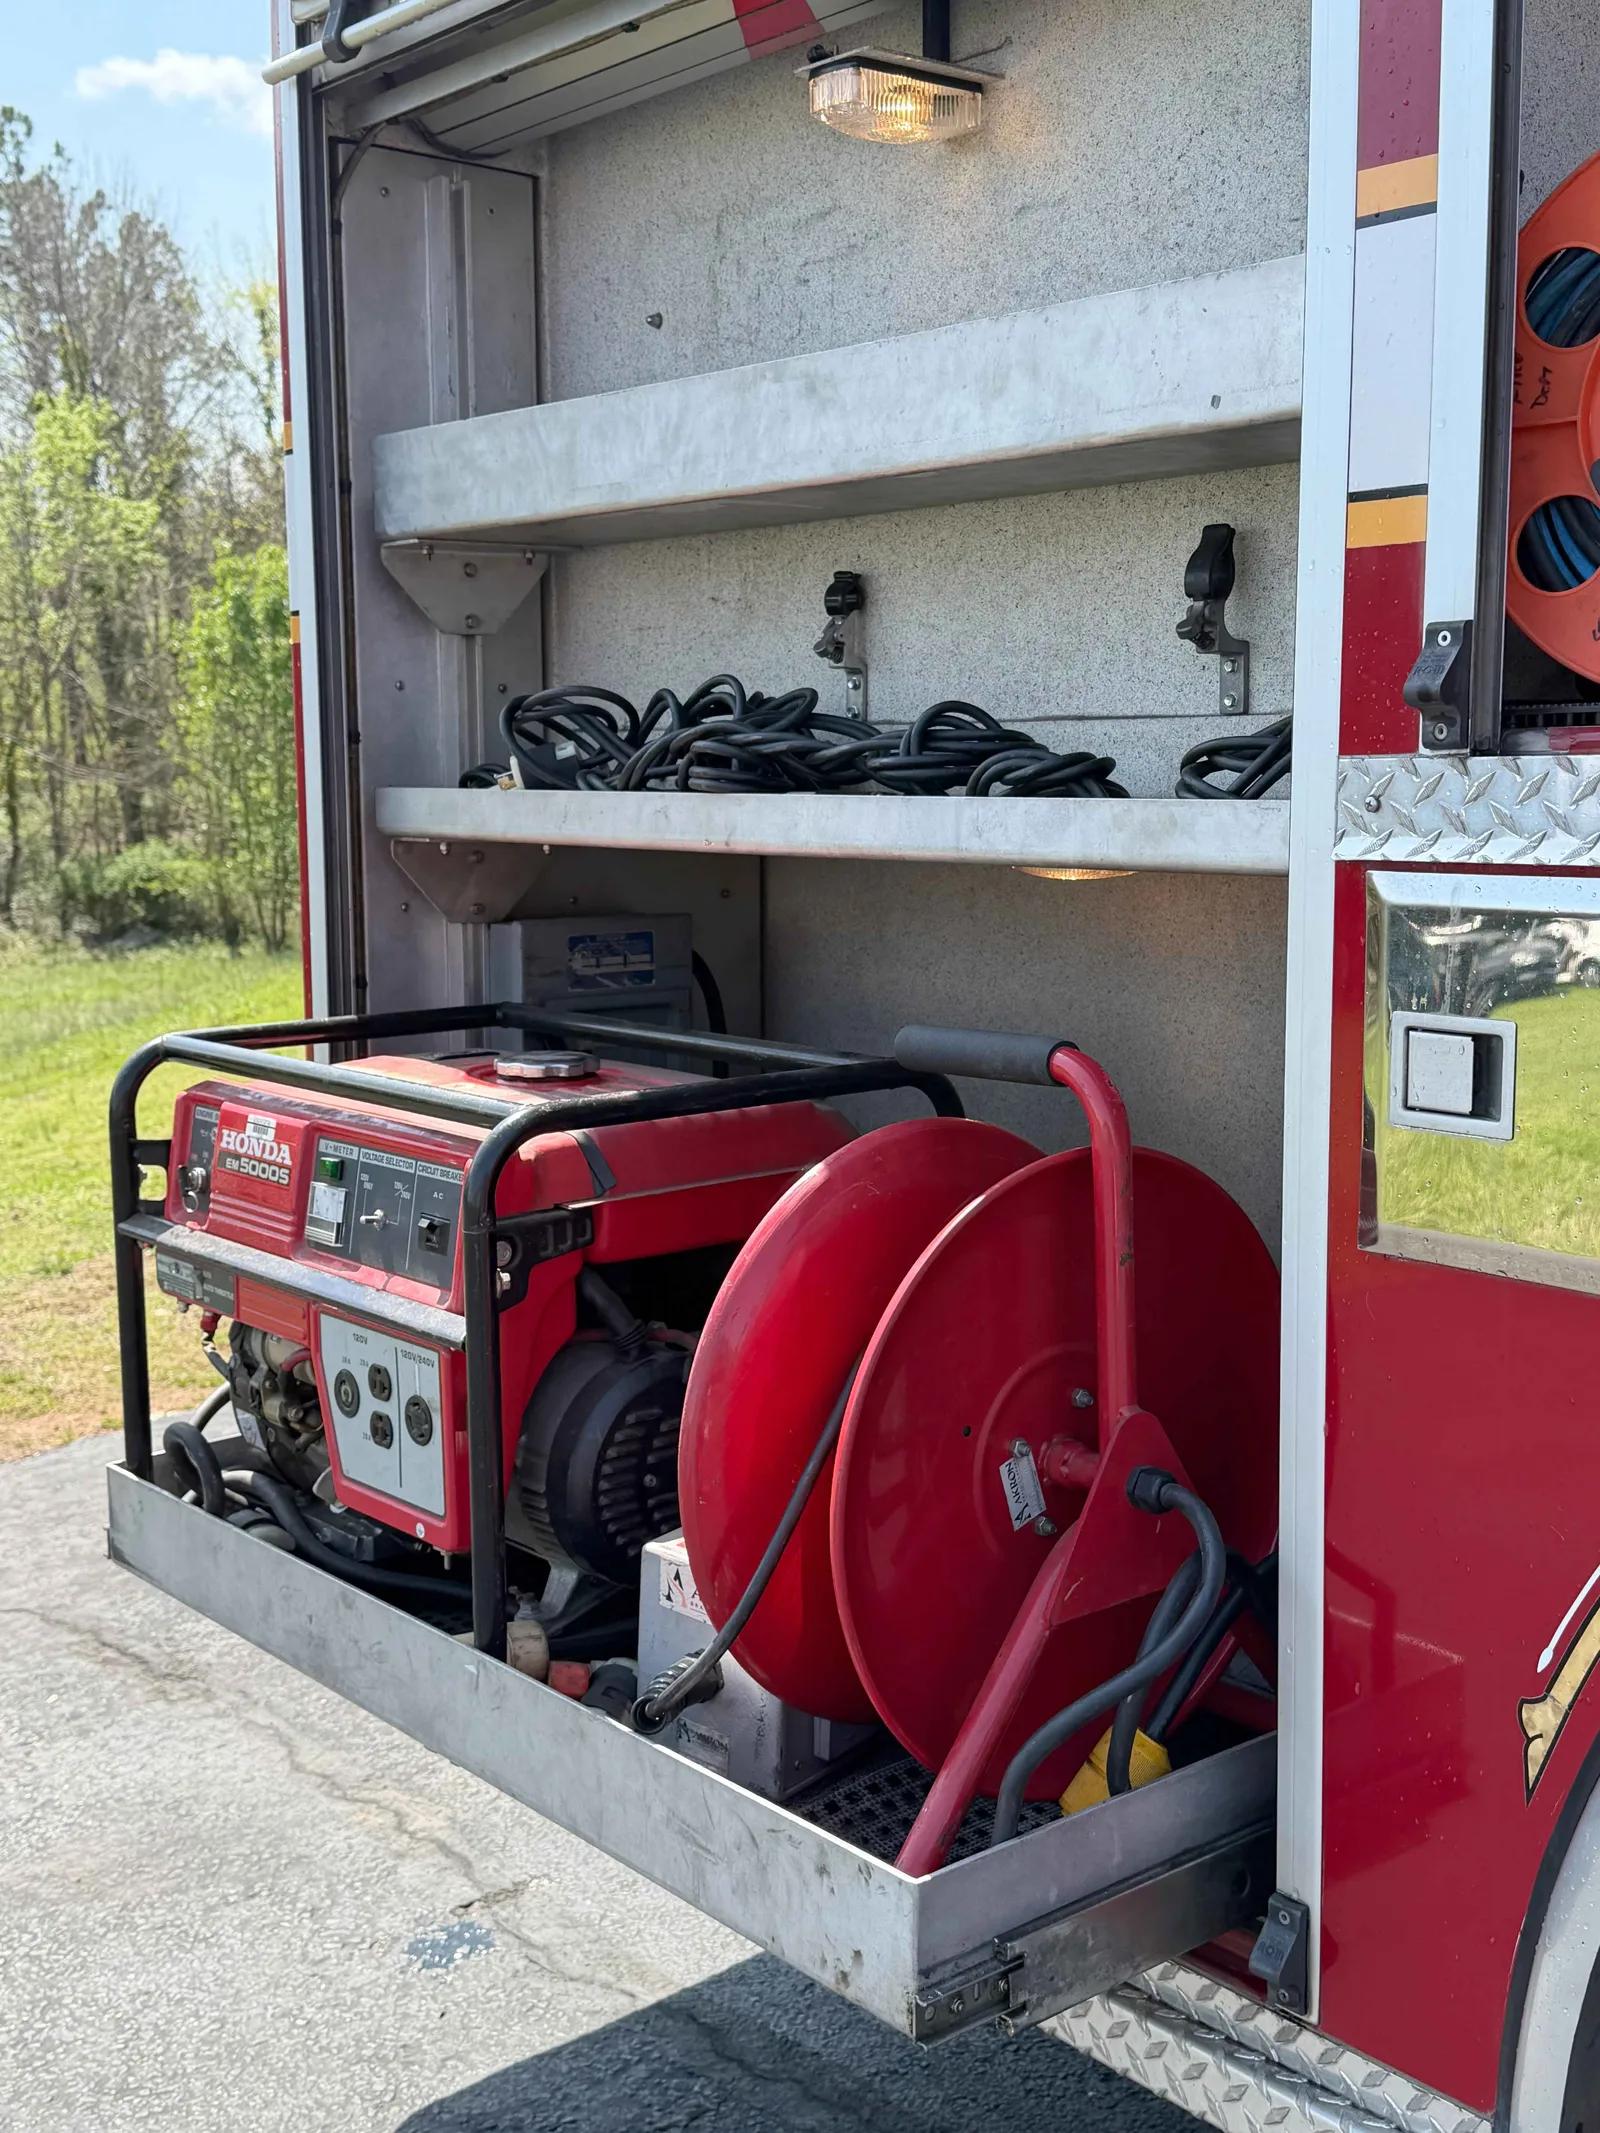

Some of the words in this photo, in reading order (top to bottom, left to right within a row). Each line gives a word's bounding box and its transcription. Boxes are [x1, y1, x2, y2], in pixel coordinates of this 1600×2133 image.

[220, 1129, 292, 1165] HONDA
[361, 1151, 384, 1163] VOLTAGE
[385, 1156, 413, 1170] SELECTOR
[418, 1163, 439, 1176] CIRCUIT
[440, 1168, 464, 1182] BREAKE
[352, 1333, 368, 1345] 120V
[400, 1348, 435, 1368] 120V/240V
[1005, 1462, 1022, 1504] AKRON
